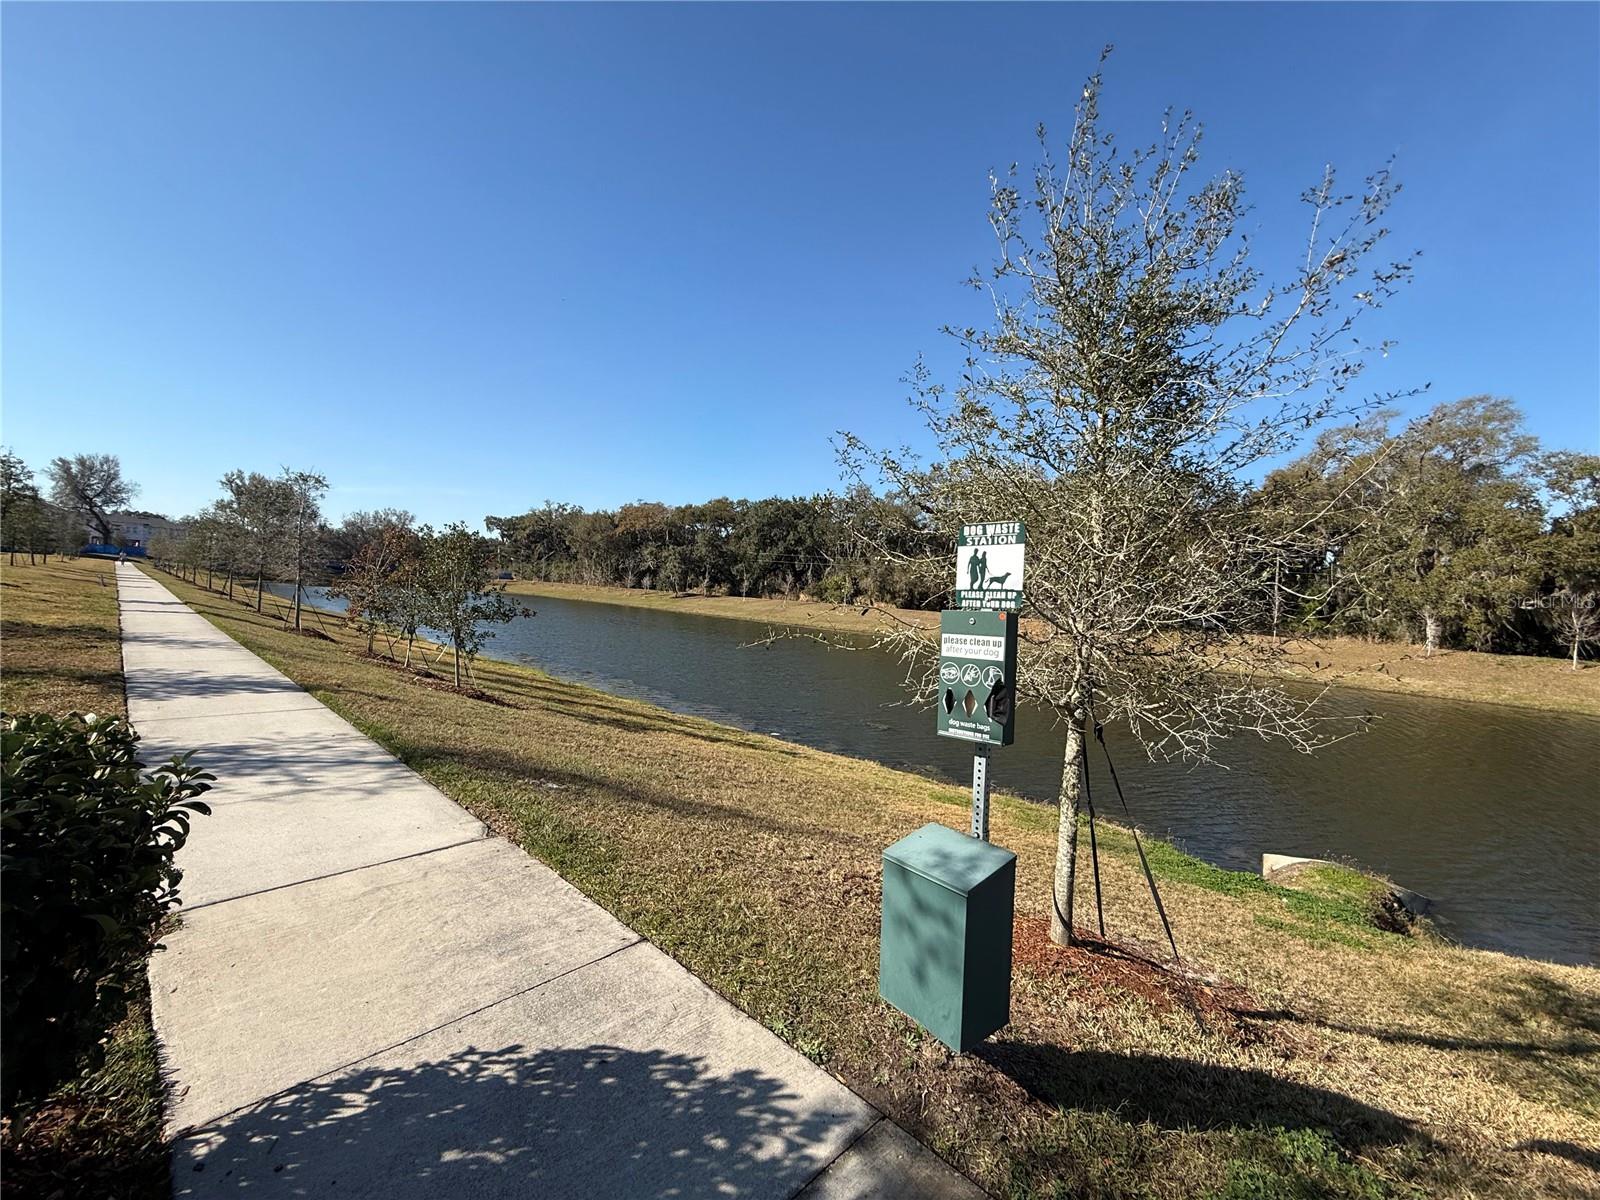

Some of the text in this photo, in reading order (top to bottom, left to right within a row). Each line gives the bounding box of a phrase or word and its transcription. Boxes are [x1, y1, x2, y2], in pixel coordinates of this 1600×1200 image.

[963, 522, 1020, 536] DOG WASTE
[966, 535, 1017, 546] STATION
[960, 590, 1017, 599] PLEASE CLEAN UP
[961, 599, 981, 607] AFTER
[943, 636, 1002, 648] please clean up
[945, 645, 1000, 658] after your dog
[948, 718, 991, 732] dog waste bags
